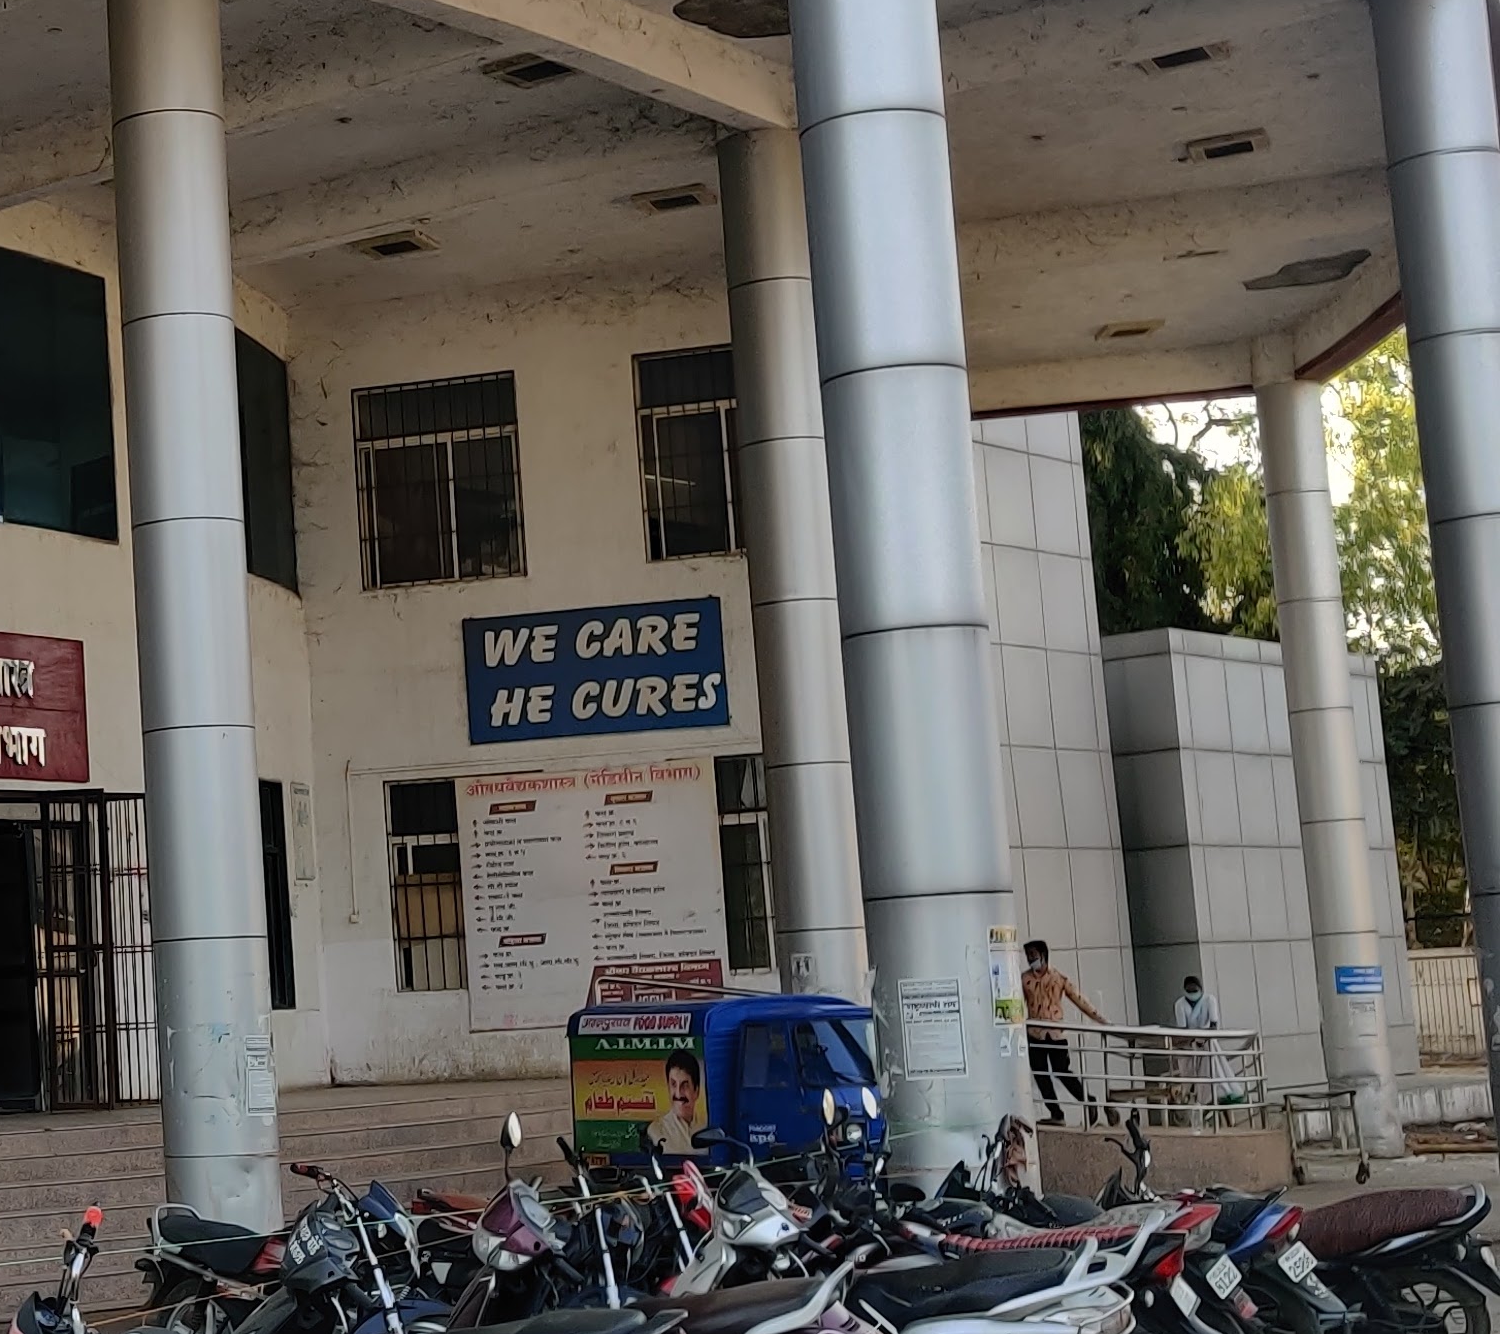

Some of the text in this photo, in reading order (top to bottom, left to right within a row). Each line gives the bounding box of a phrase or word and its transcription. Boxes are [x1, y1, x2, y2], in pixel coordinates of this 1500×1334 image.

[484, 612, 700, 668] WE CARE
[490, 672, 722, 727] HE CURES
